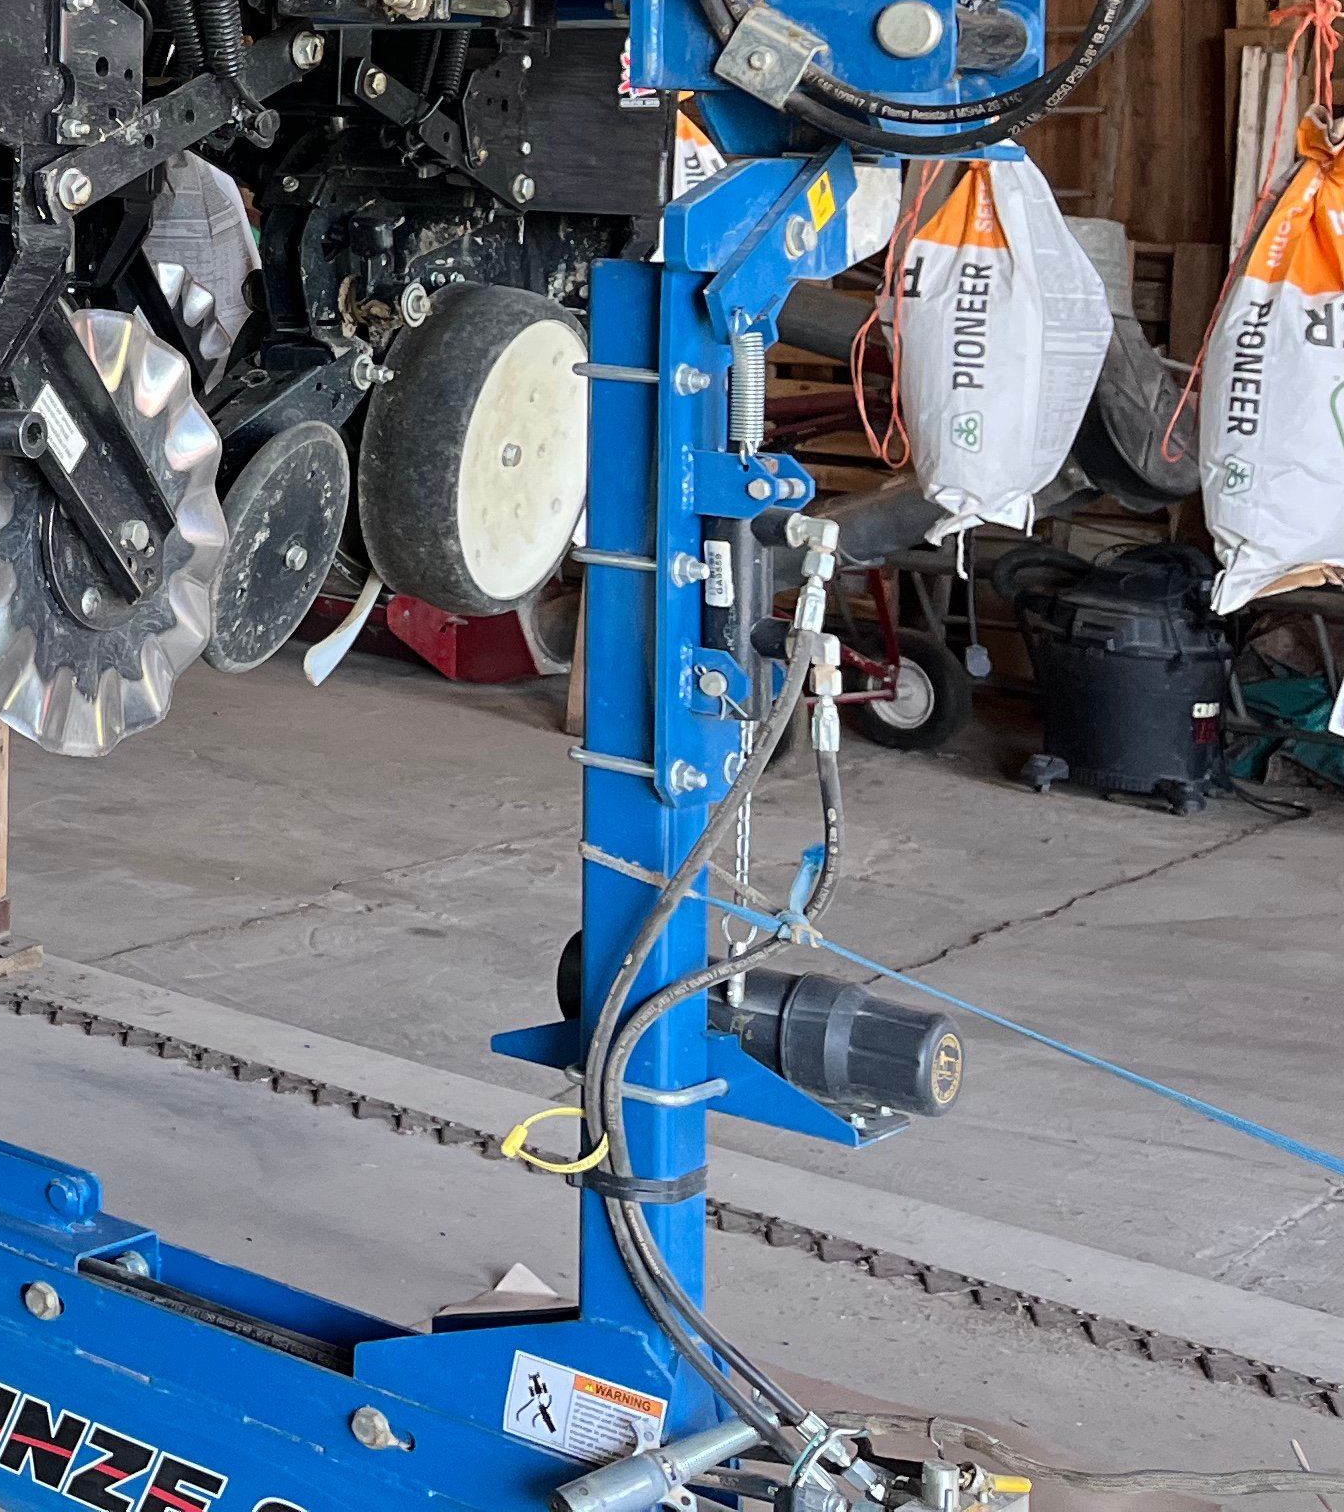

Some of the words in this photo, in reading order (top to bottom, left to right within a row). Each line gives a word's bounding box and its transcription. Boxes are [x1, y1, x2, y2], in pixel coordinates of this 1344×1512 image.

[952, 262, 993, 390] PIONEER
[1227, 298, 1274, 437] PIONEER
[595, 1384, 651, 1412] WARNING
